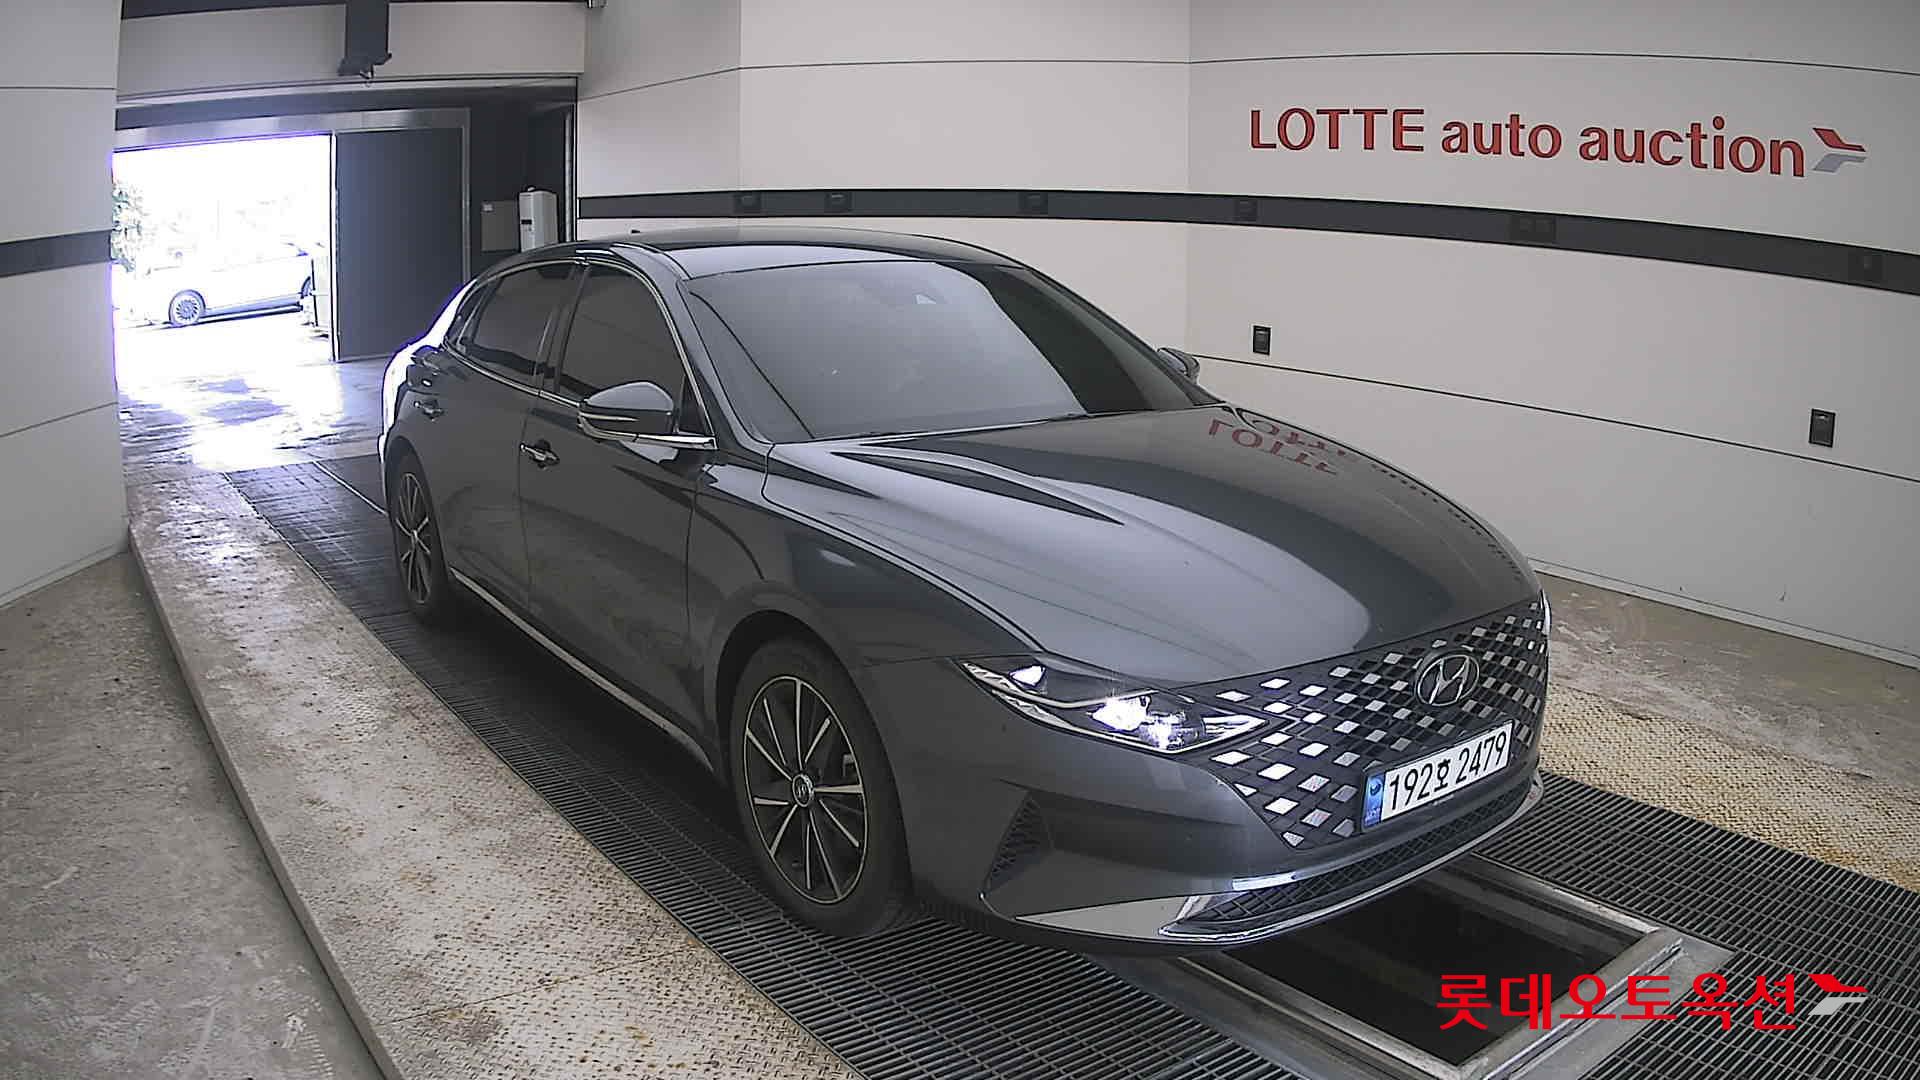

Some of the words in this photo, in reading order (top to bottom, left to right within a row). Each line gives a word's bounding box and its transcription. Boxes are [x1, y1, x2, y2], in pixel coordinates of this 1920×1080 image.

[1250, 107, 1425, 151] LOTTE
[1442, 114, 1562, 158] auto
[1579, 116, 1806, 177] auction
[1389, 758, 1451, 811] 192호
[1456, 731, 1507, 784] 2479
